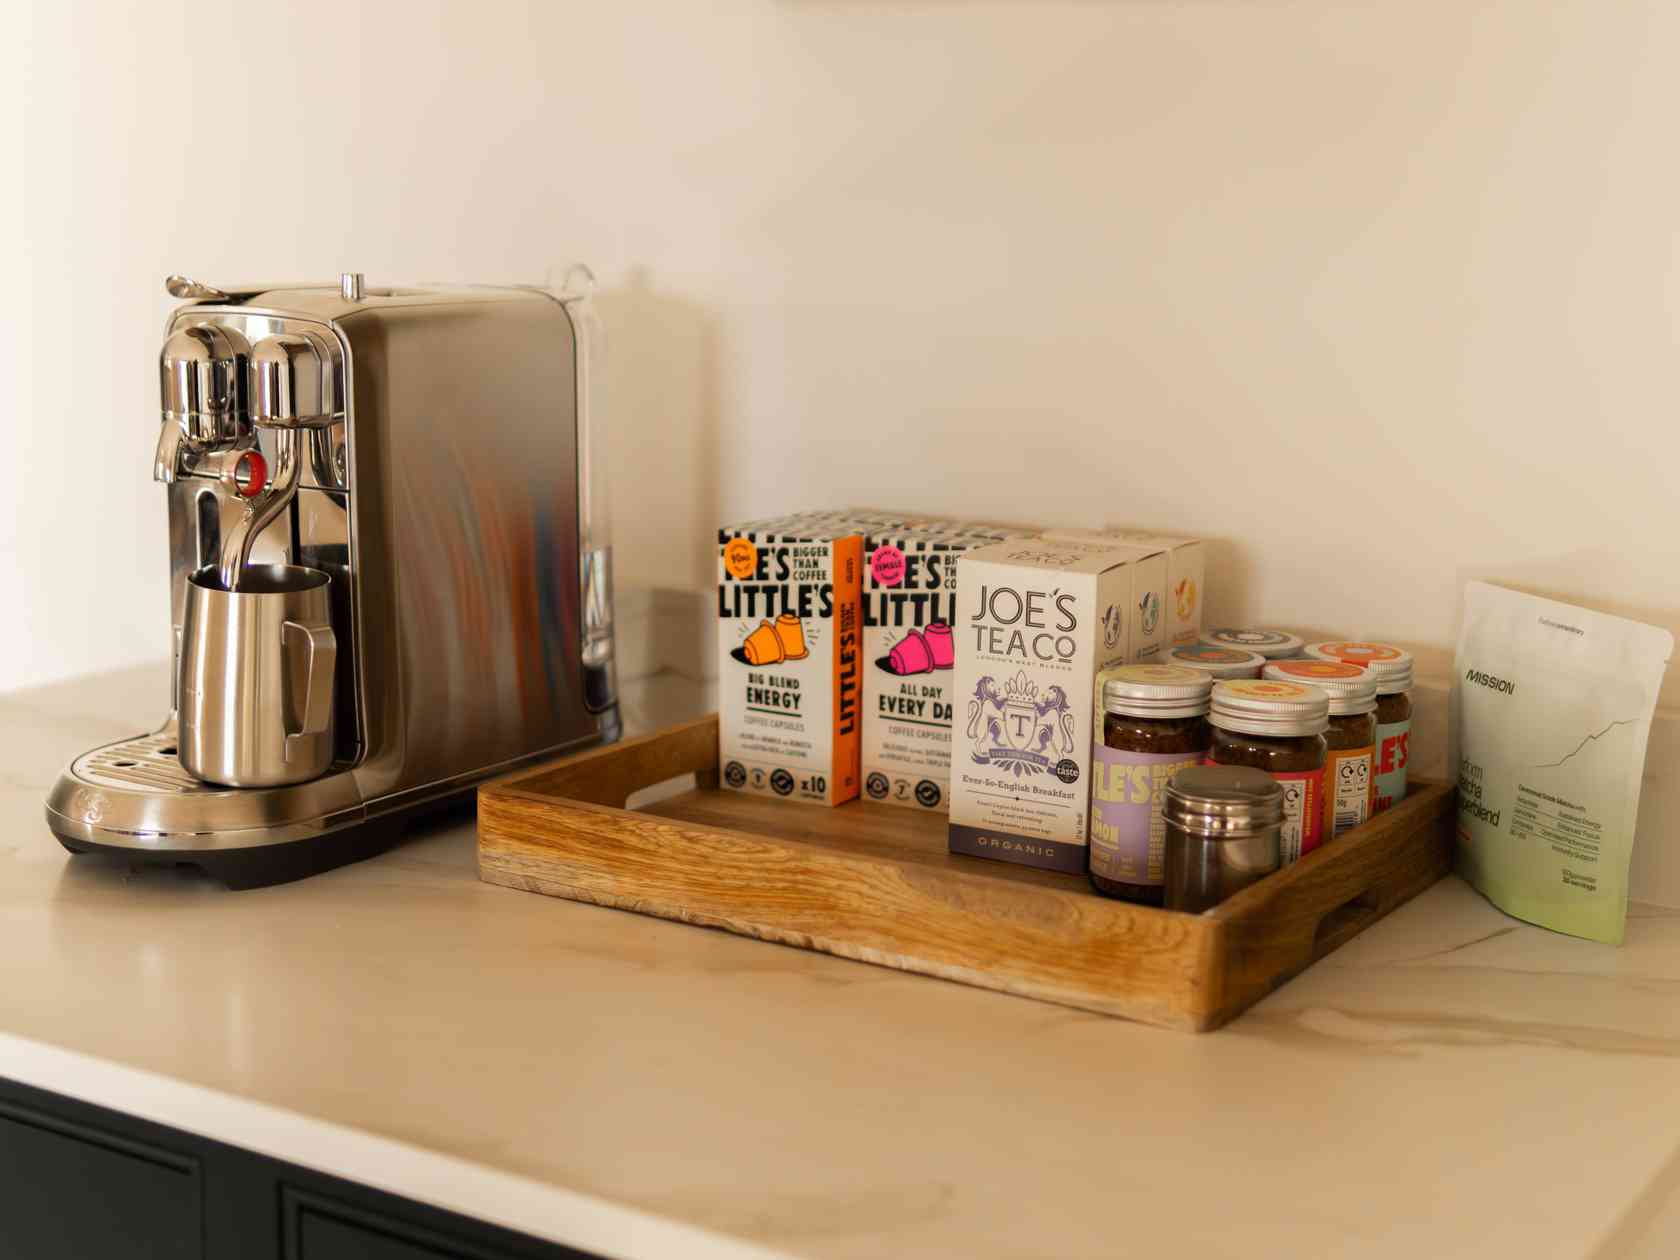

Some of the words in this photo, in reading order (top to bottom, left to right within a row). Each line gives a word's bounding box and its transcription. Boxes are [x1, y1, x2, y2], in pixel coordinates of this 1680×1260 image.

[793, 546, 829, 557] BIGGER
[793, 558, 819, 569] THAN
[793, 570, 828, 581] COFFEE
[719, 584, 833, 618] LITTLE'S
[971, 584, 1077, 632] JOE'S
[748, 672, 764, 685] BIG
[769, 675, 800, 690] BLEND
[840, 632, 856, 736] LITTLE'S
[900, 683, 917, 697] ALL
[921, 686, 943, 699] DAY
[1465, 669, 1515, 695] MISSION
[746, 686, 802, 710] ENERGY
[878, 694, 926, 717] EVERY
[933, 701, 952, 720] DA
[888, 726, 914, 738] COFFEE
[1010, 713, 1031, 737] T
[1057, 767, 1079, 778] taste
[1093, 761, 1152, 804] LE'S
[800, 776, 826, 793] x10
[962, 775, 1031, 793] Ever-So-English
[1032, 785, 1076, 799] Breakfast
[976, 836, 1055, 857] ORGANIC
